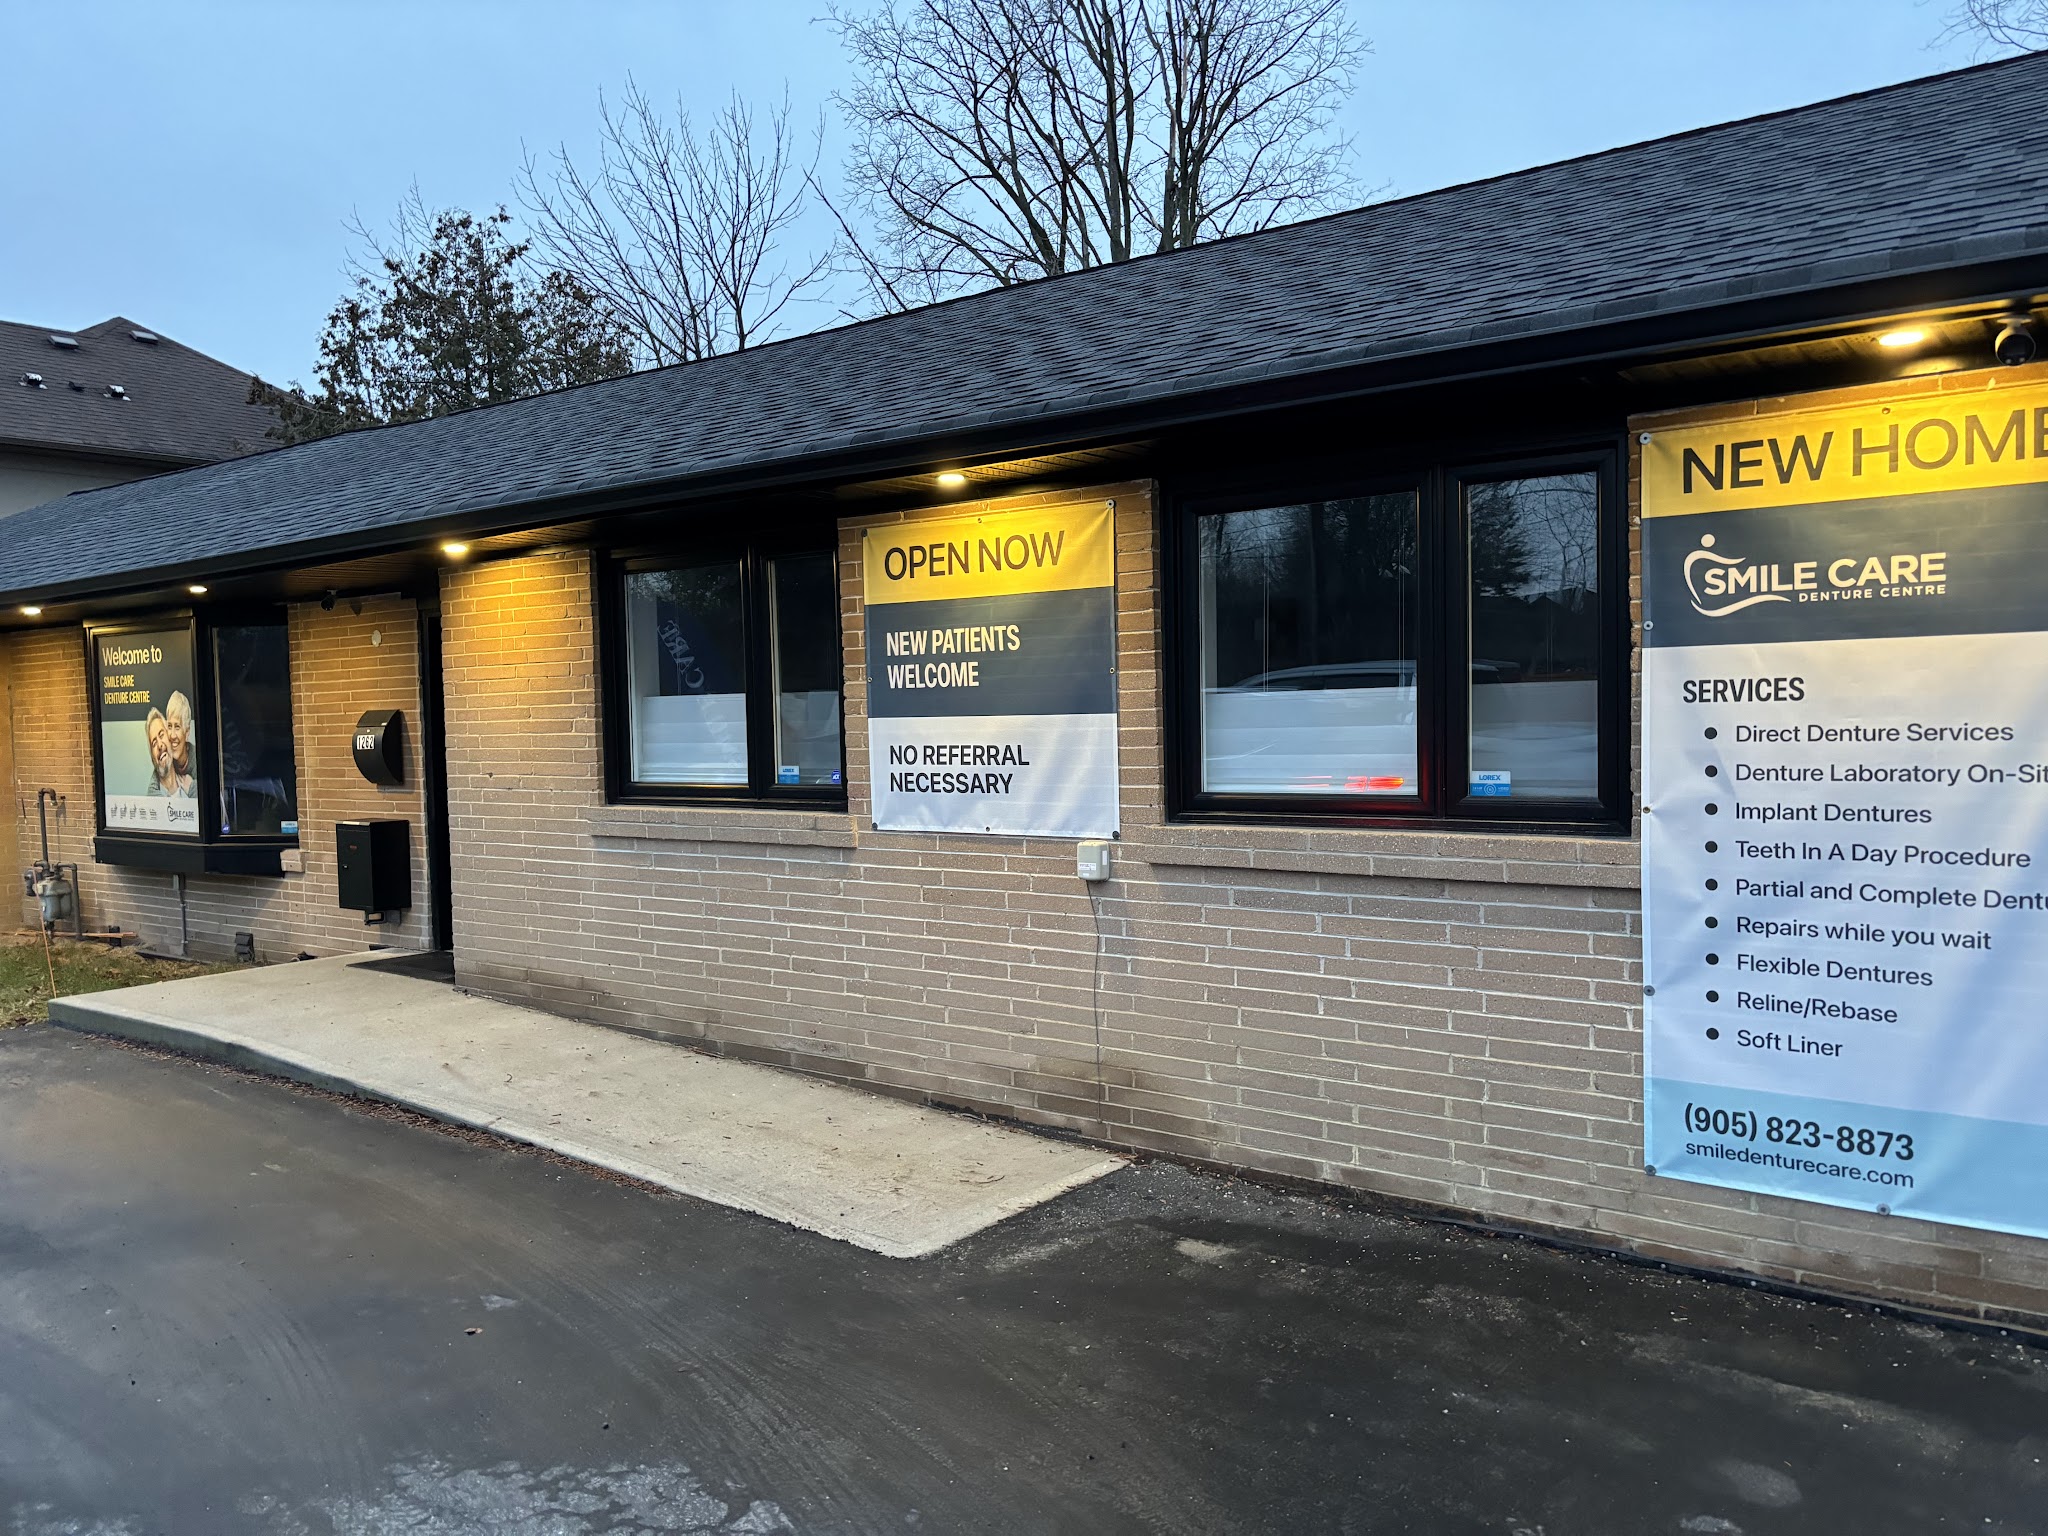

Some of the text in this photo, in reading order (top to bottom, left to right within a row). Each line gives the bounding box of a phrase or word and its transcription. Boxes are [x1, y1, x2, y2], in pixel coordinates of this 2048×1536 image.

[1683, 431, 1834, 494] NEW
[885, 530, 1065, 580] OPEN NOW
[1704, 552, 1946, 596] SMILE CARE
[1799, 584, 1946, 602] DENTURE CENTRE
[887, 625, 1021, 656] NEW PATIENTS
[102, 645, 162, 667] Welcome to
[104, 675, 134, 688] SMILE CARE
[888, 661, 979, 689] WELCOME
[104, 690, 150, 704] DENTURE CENTRE
[1683, 676, 1805, 704] SERVICES
[357, 736, 374, 749] 1262
[1736, 722, 2014, 742] Direct Denture Services
[890, 745, 1029, 766] NO REFERRAL
[890, 772, 1013, 794] NECESSARY
[1736, 764, 1824, 781] Denture
[1830, 764, 1960, 787] Laboratory
[1736, 802, 1932, 824] Implant Dentures
[1736, 840, 2031, 867] Teeth In A Day Procedure
[1736, 878, 2048, 911] Partial and Complete Dent
[1737, 916, 1992, 950] Repairs while you wait
[1737, 954, 1933, 986] Flexible Dentures
[1737, 991, 1898, 1023] Reline/Rebase
[1737, 1029, 1843, 1057] Soft Liner
[1684, 1103, 1914, 1161] (905) 823-8873
[1686, 1141, 1914, 1188] smiledenturecare.com
